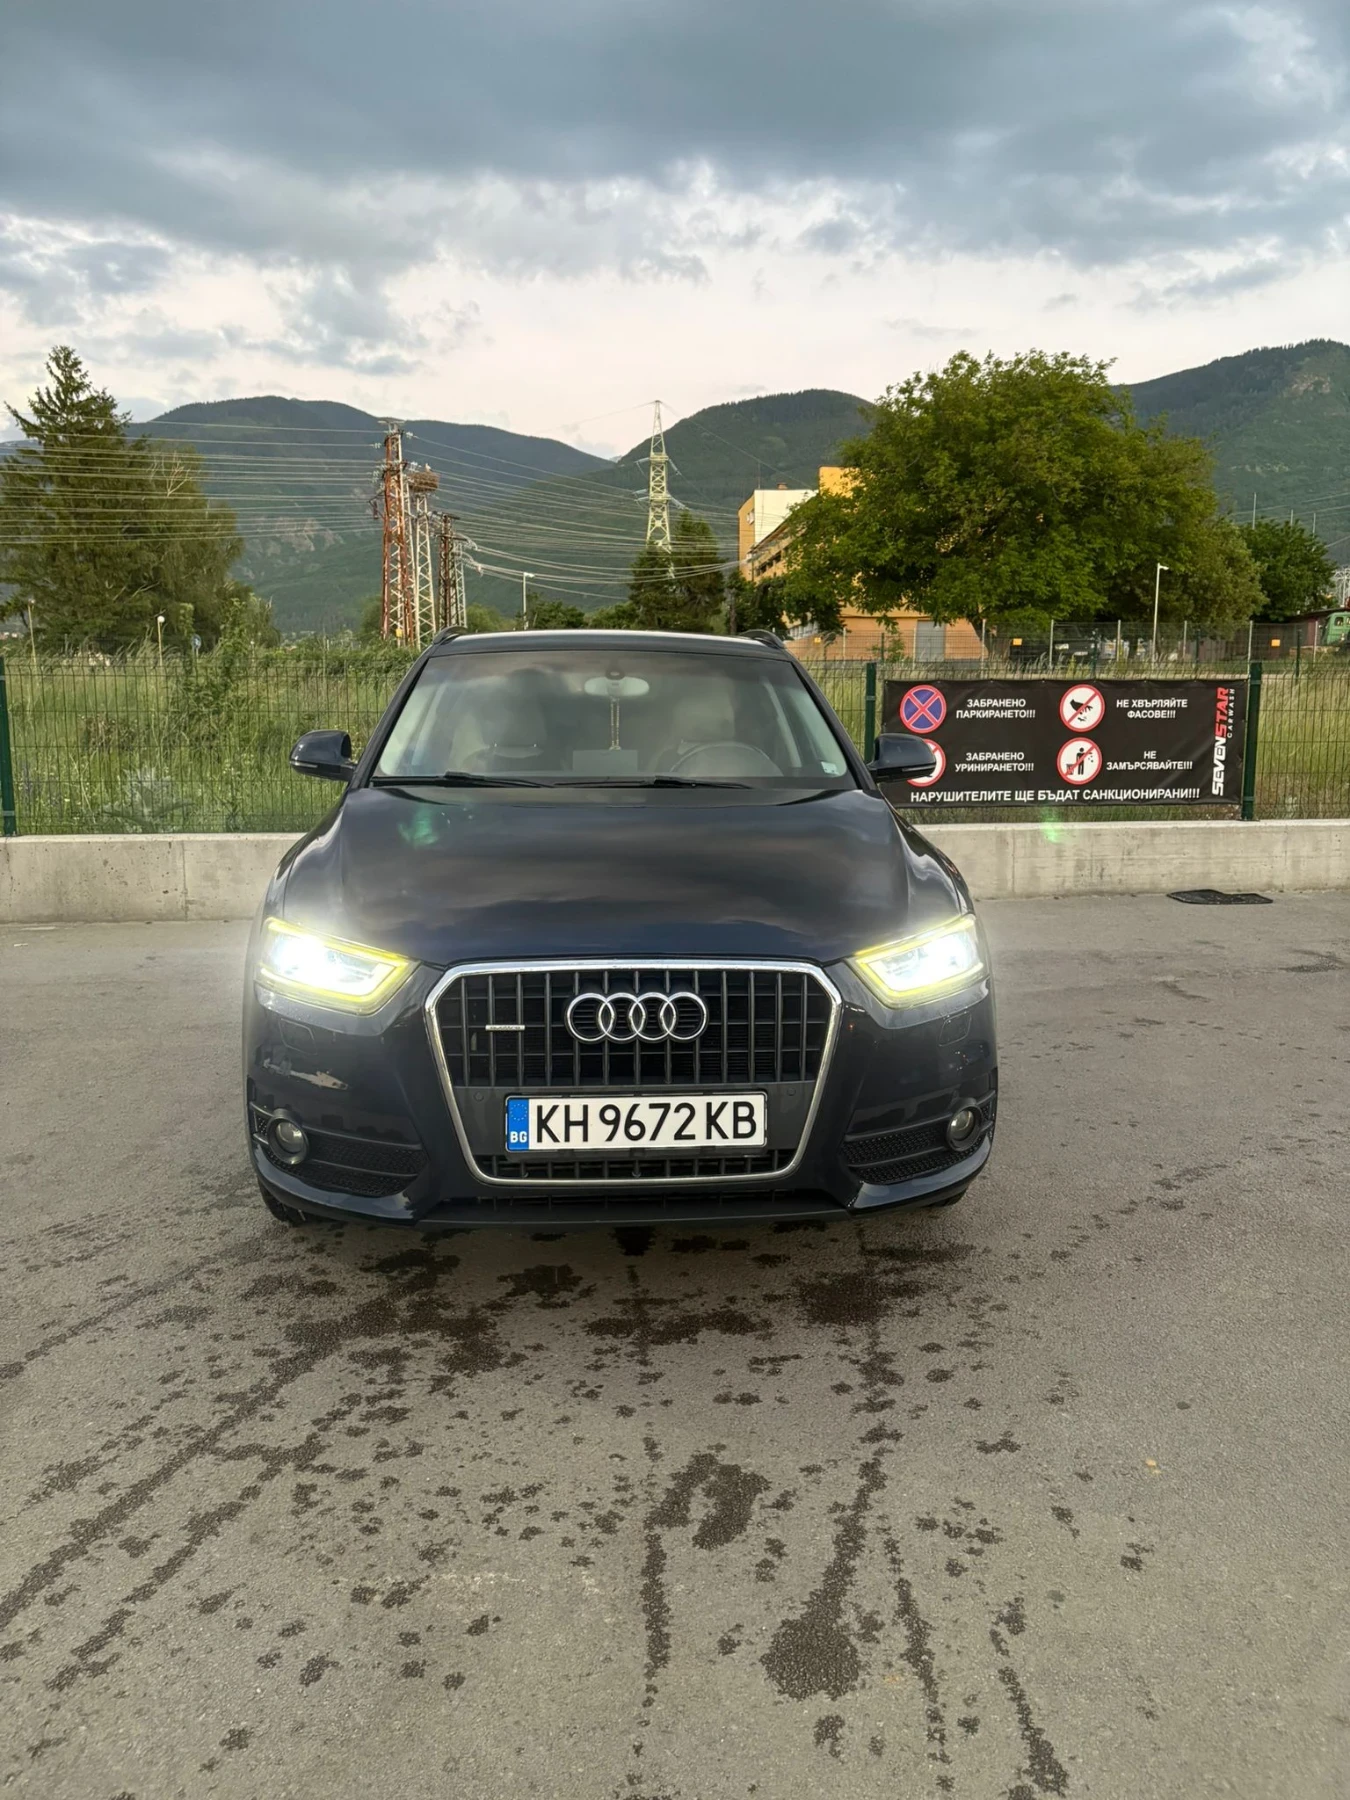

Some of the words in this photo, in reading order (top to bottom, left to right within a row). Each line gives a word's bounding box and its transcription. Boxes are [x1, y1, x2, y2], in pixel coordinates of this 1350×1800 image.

[966, 698, 1026, 709] ЗАБРАНЕНО
[1116, 699, 1130, 708] НЕ
[1132, 698, 1188, 708] ХВЪРЛЯЙТЕ
[955, 709, 1036, 719] ПАРКИРАНЕТО!!!
[1127, 709, 1176, 719] ФАСОВЕ!!!
[965, 752, 1024, 762] ЗАБРАНЕНО
[1142, 751, 1157, 760] НЕ
[955, 762, 1035, 773] УРИНИРАНЕТО!!!
[1106, 760, 1193, 771] ЗАМЪРСЯВАЙТЕ!!!
[910, 791, 1012, 803] НАРУШИТЕЛИТЕ
[1015, 790, 1035, 803] ЩЕ
[1038, 789, 1080, 802] БЪДАТ
[1082, 787, 1200, 801] САНКЦИОНИРАНИ!!!
[536, 1104, 588, 1142] KH
[599, 1103, 696, 1141] 9672
[706, 1101, 757, 1139] KB
[510, 1131, 527, 1143] BG
